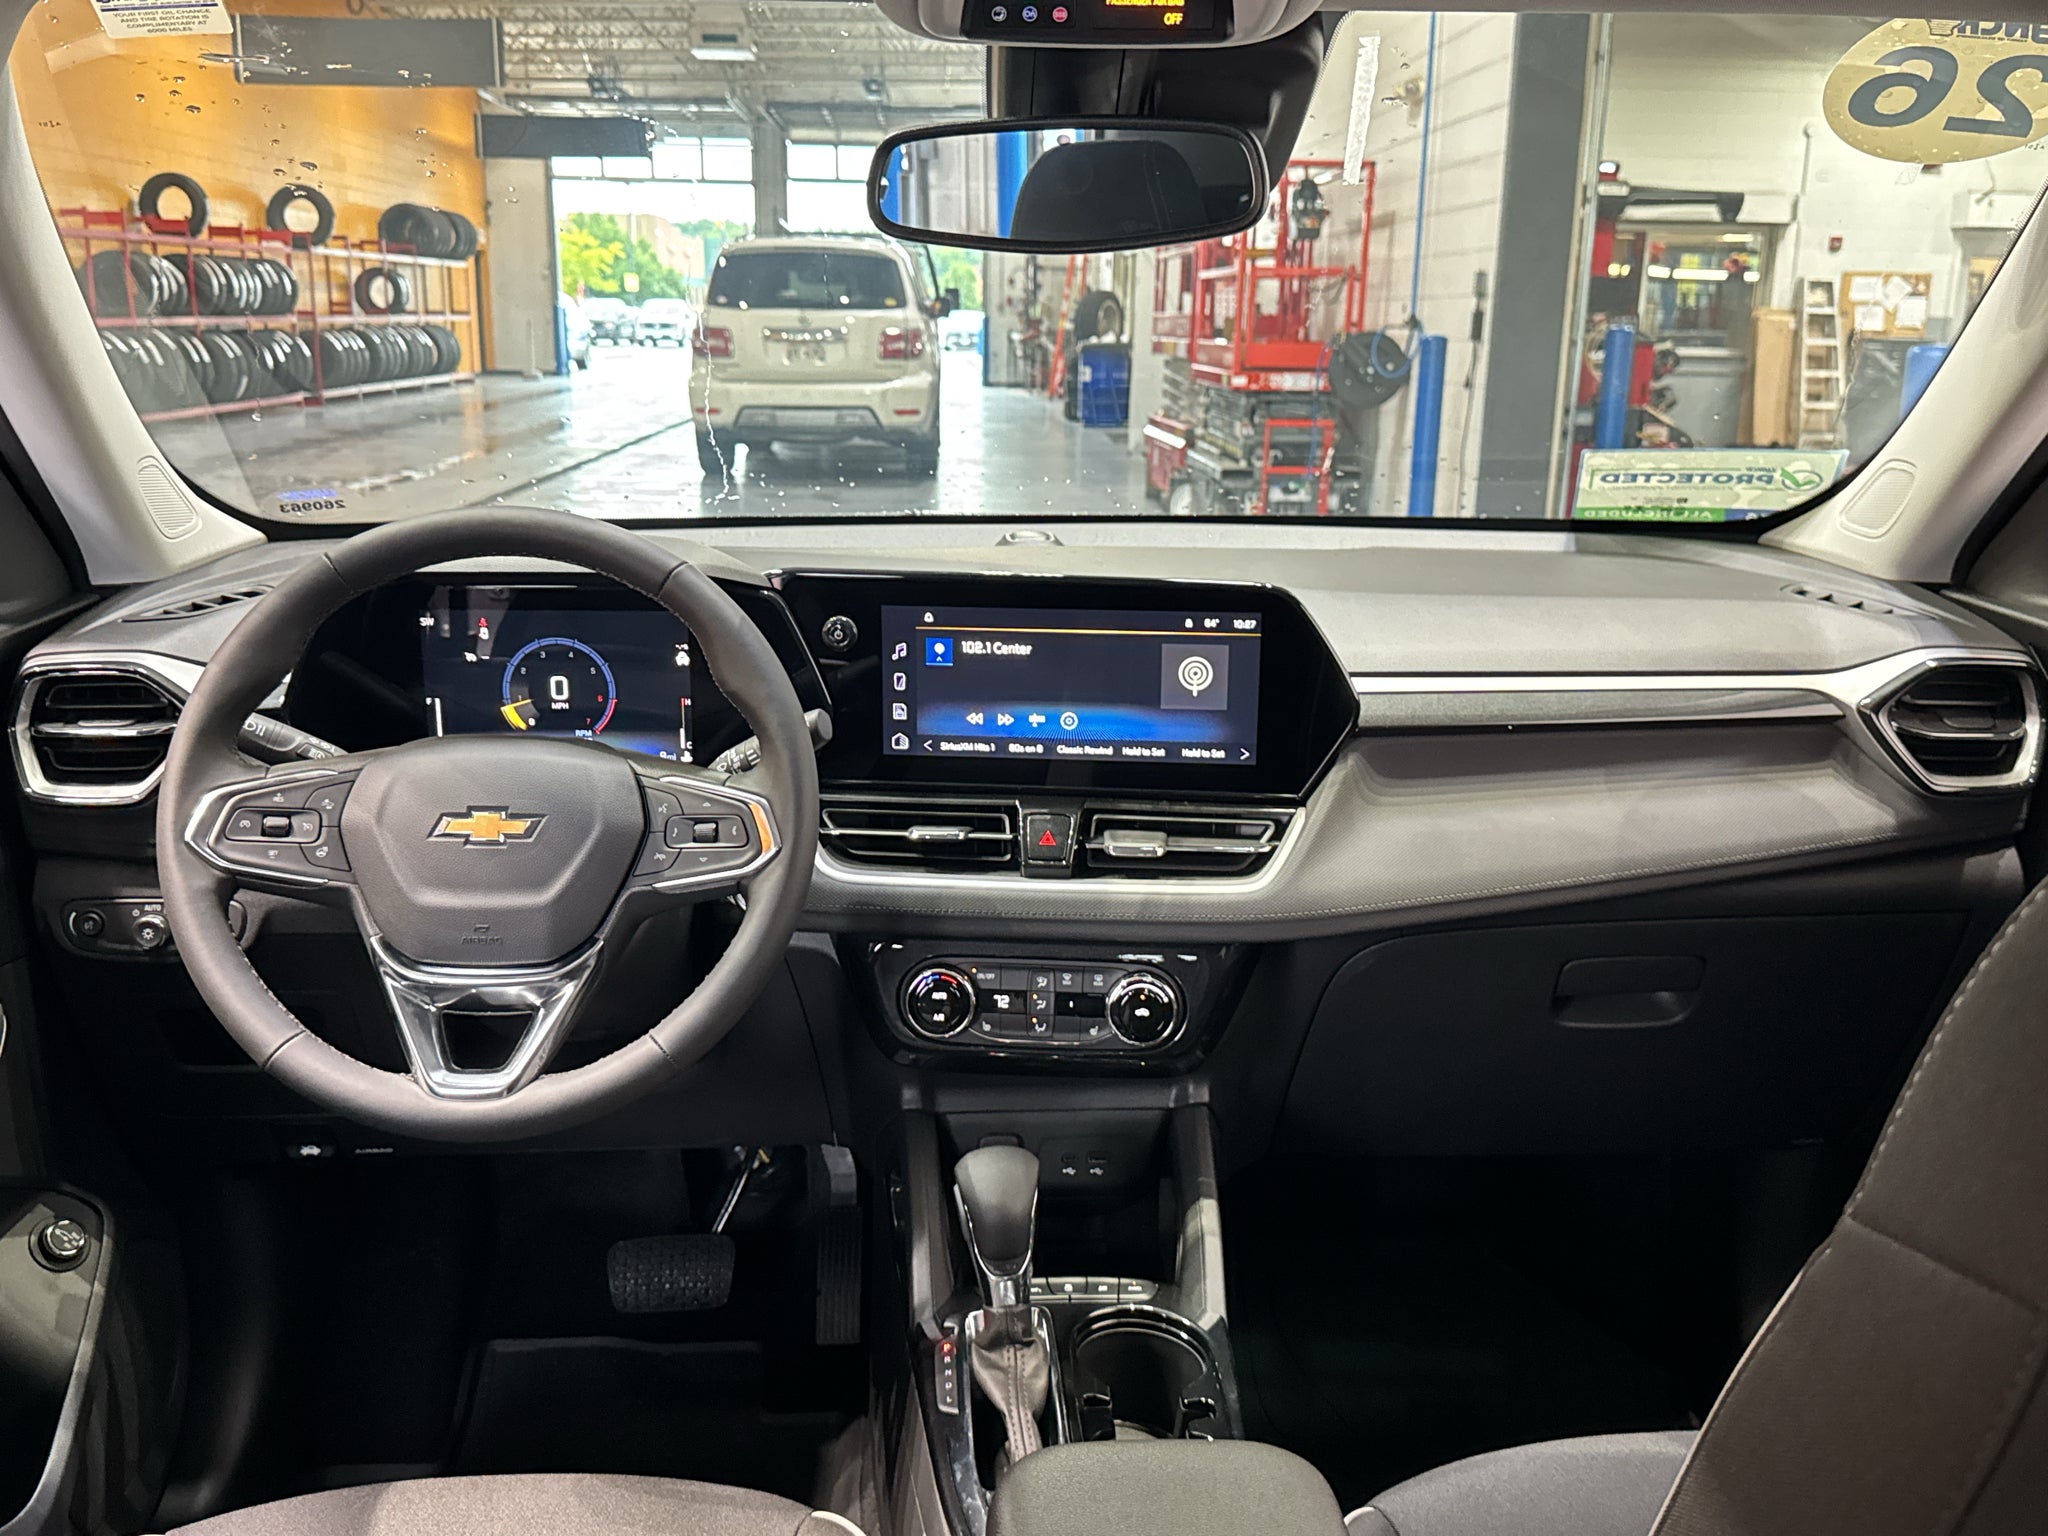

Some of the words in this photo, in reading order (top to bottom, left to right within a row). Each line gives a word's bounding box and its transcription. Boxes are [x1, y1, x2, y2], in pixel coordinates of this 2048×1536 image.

[1163, 12, 1184, 25] OFF
[126, 20, 196, 29] COMPLIMENTARY
[419, 617, 434, 627] SW
[961, 640, 992, 654] 102.1
[993, 641, 1033, 655] Center
[550, 675, 569, 700] 0
[551, 702, 570, 710] MPH
[1122, 747, 1141, 756] Hold
[1151, 747, 1166, 757] Set
[1181, 748, 1201, 758] Hold
[1211, 749, 1226, 759] Set
